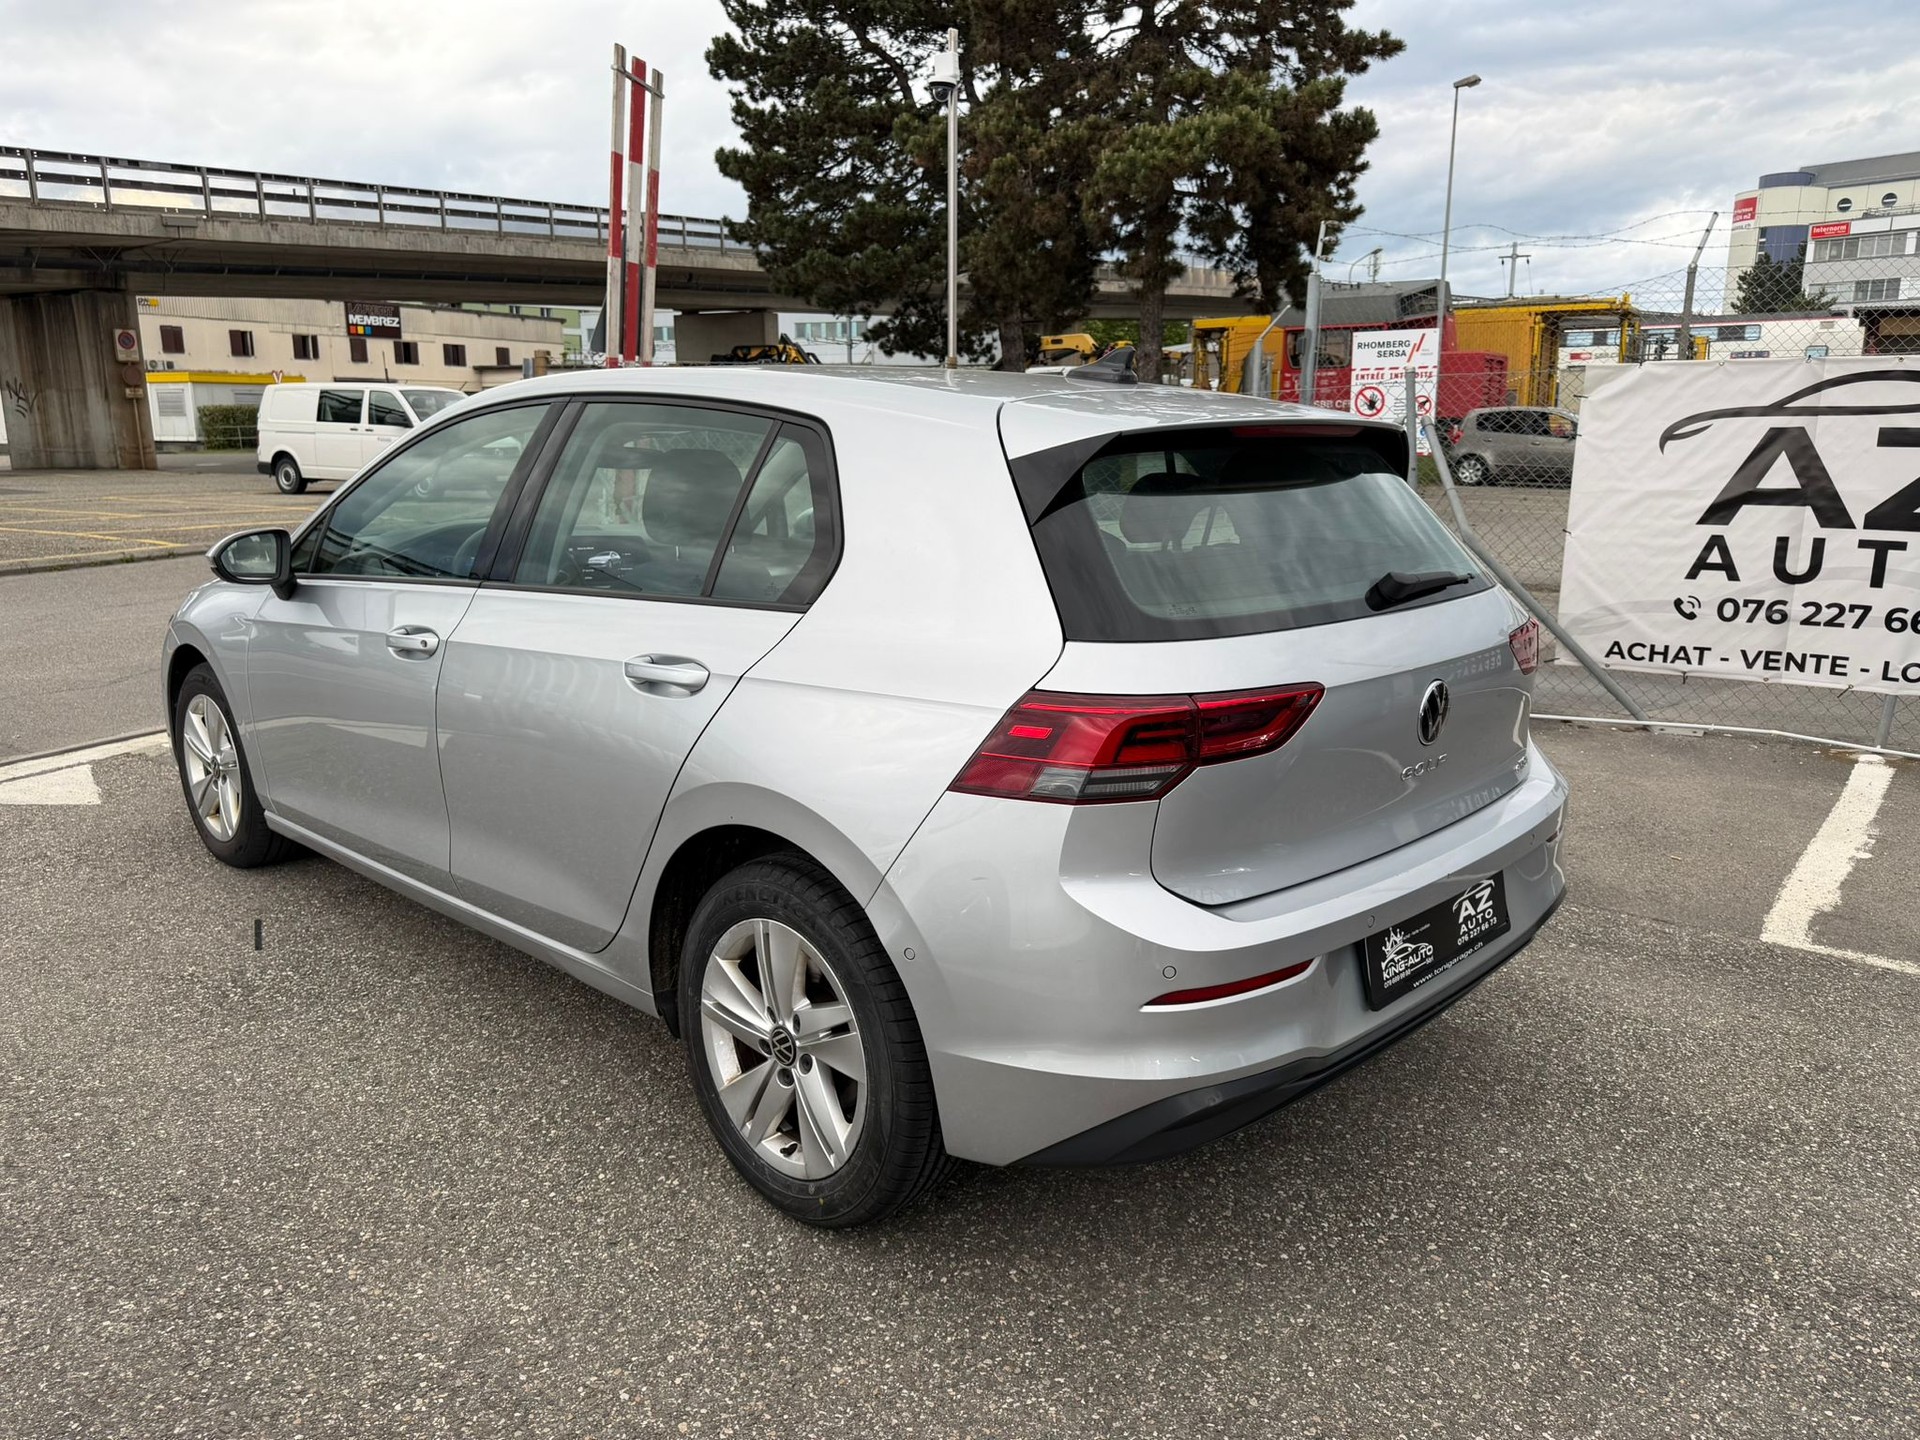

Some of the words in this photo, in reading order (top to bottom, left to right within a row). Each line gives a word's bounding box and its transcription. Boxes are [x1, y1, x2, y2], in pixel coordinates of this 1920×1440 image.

[1813, 223, 1848, 234] Internorm
[348, 313, 400, 328] MEMBREZ
[1357, 339, 1411, 350] RHOMBERG
[1376, 349, 1407, 359] SERSA
[1355, 371, 1386, 381] ENTRÉE
[1390, 370, 1434, 381] INTDITE
[1314, 400, 1334, 409] SBB
[1684, 535, 1908, 589] AUT
[1717, 597, 1789, 625] 076
[1799, 601, 1873, 629] 227
[1604, 640, 1712, 666] ACHAT
[1740, 649, 1850, 677] VENTE
[1401, 753, 1448, 781] GOLF
[1458, 887, 1493, 924] AZ
[1457, 934, 1469, 946] 076
[1470, 926, 1480, 939] 227
[1481, 921, 1490, 931] 66
[1489, 916, 1498, 926] 73
[1460, 908, 1493, 936] AUTO
[1383, 944, 1434, 981] KING-AUTO
[1413, 941, 1484, 988] www.tonigarage.ch
